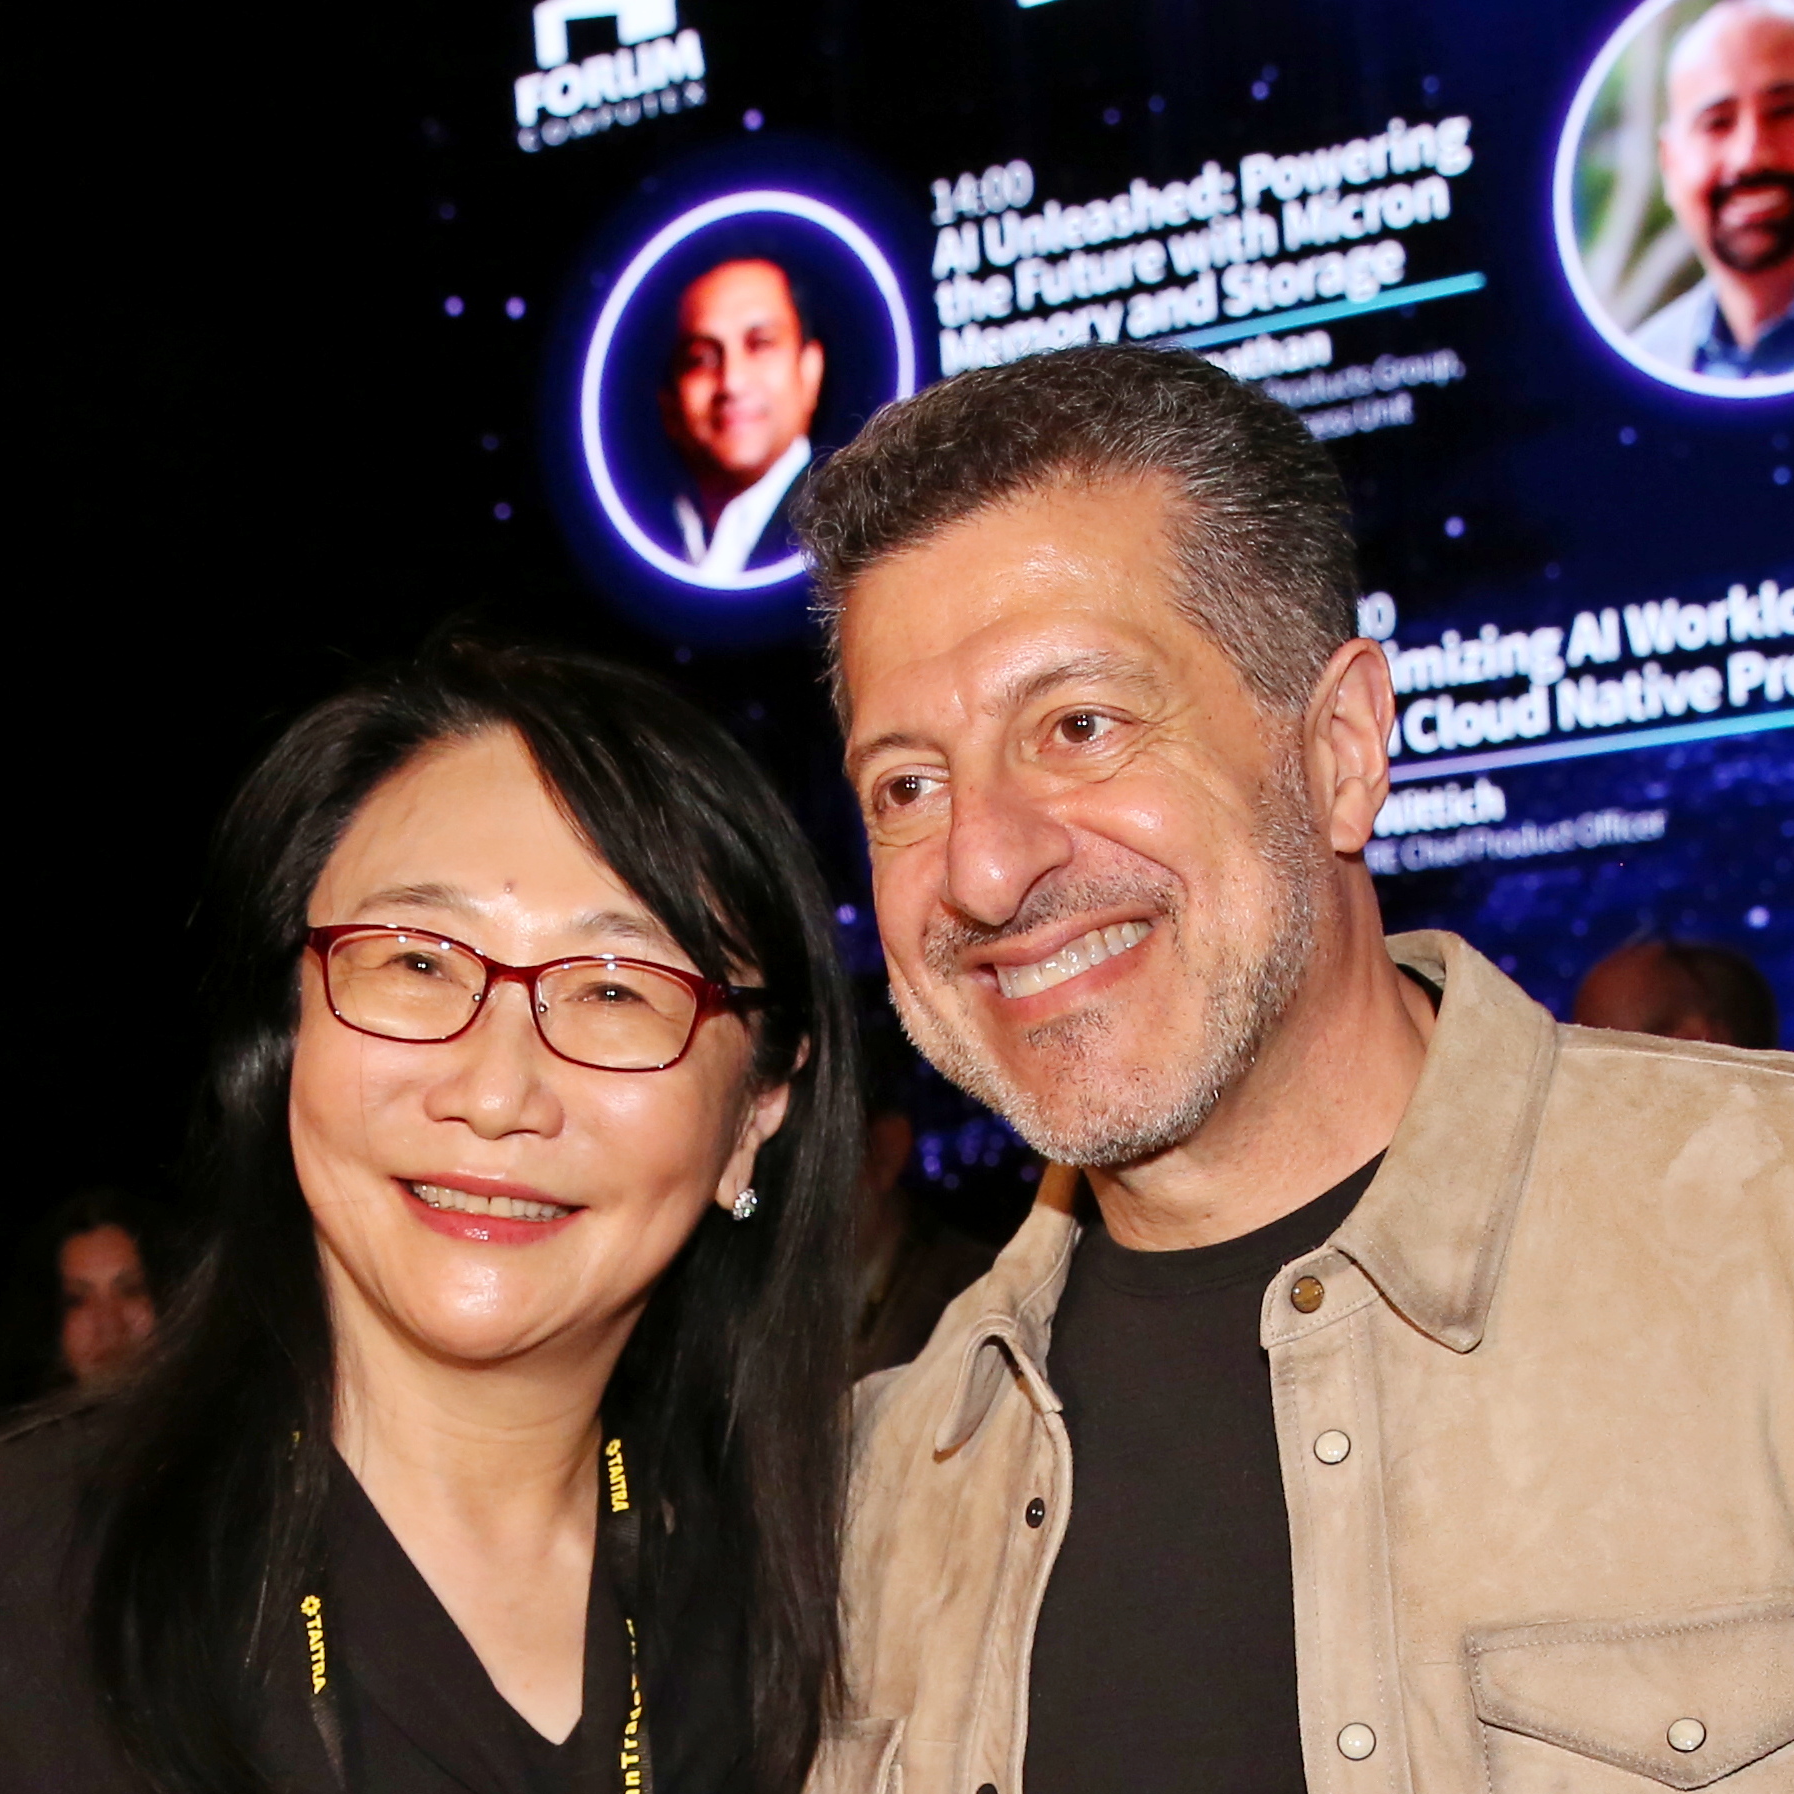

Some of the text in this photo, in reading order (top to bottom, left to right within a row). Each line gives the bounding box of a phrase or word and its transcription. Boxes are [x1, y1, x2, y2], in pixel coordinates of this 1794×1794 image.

[514, 27, 705, 128] FORUM
[932, 115, 1473, 281] AI Unleashed: Powering
[934, 175, 1451, 328] the Future with Micron
[1125, 268, 1218, 339] and
[1221, 239, 1407, 318] Storage
[1385, 623, 1567, 694] imizing
[1566, 606, 1621, 668] AI
[1403, 683, 1551, 754] Cloud
[1555, 660, 1724, 733] Native
[607, 1452, 630, 1513] TAITRA
[306, 1614, 327, 1695] TAITRA
